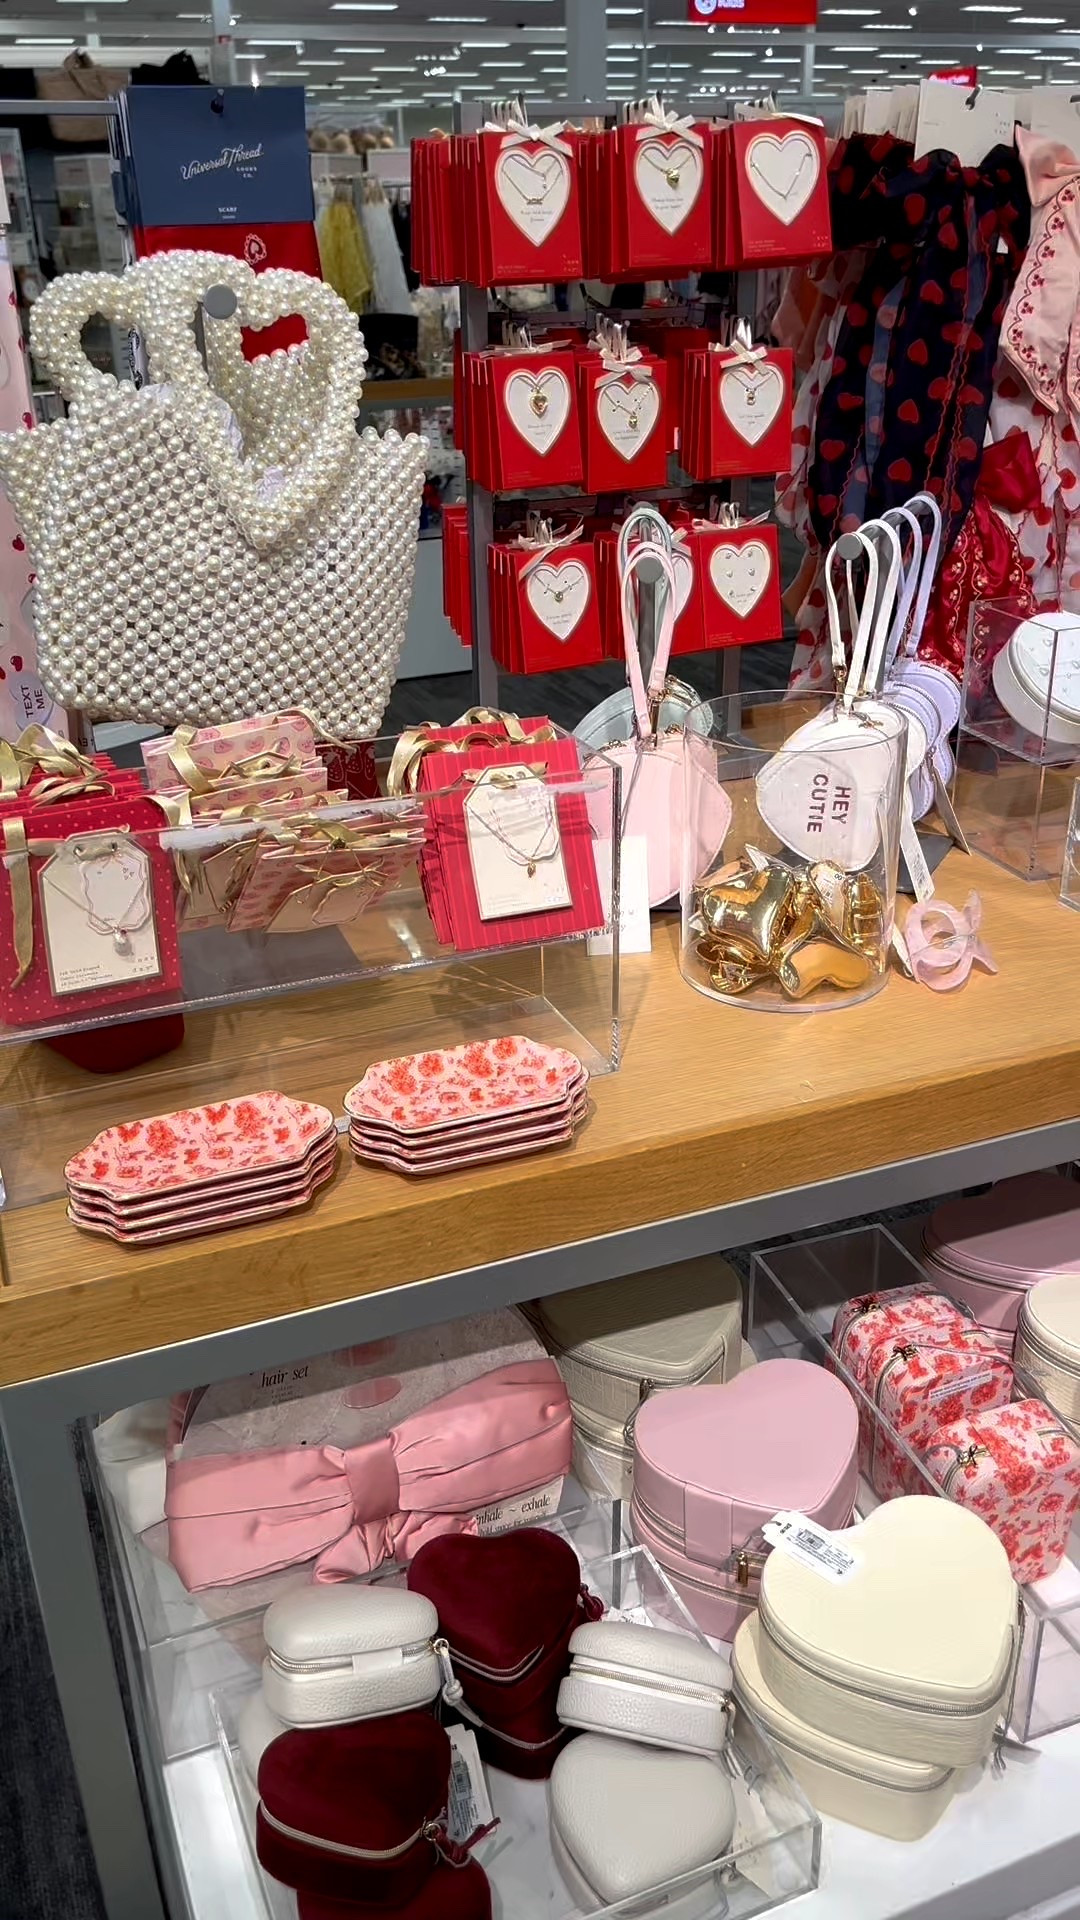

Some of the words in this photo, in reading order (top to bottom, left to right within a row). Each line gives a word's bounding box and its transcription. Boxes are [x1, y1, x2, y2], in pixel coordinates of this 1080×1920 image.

[181, 152, 228, 180] Universal
[221, 143, 264, 169] Thread
[21, 684, 34, 719] TEXT
[34, 688, 46, 710] ME
[806, 773, 829, 833] CUTIE
[831, 785, 852, 825] HEY
[261, 1369, 288, 1388] hair
[292, 1365, 309, 1380] set
[476, 1507, 503, 1526] inhale
[521, 1493, 551, 1513] exhale
